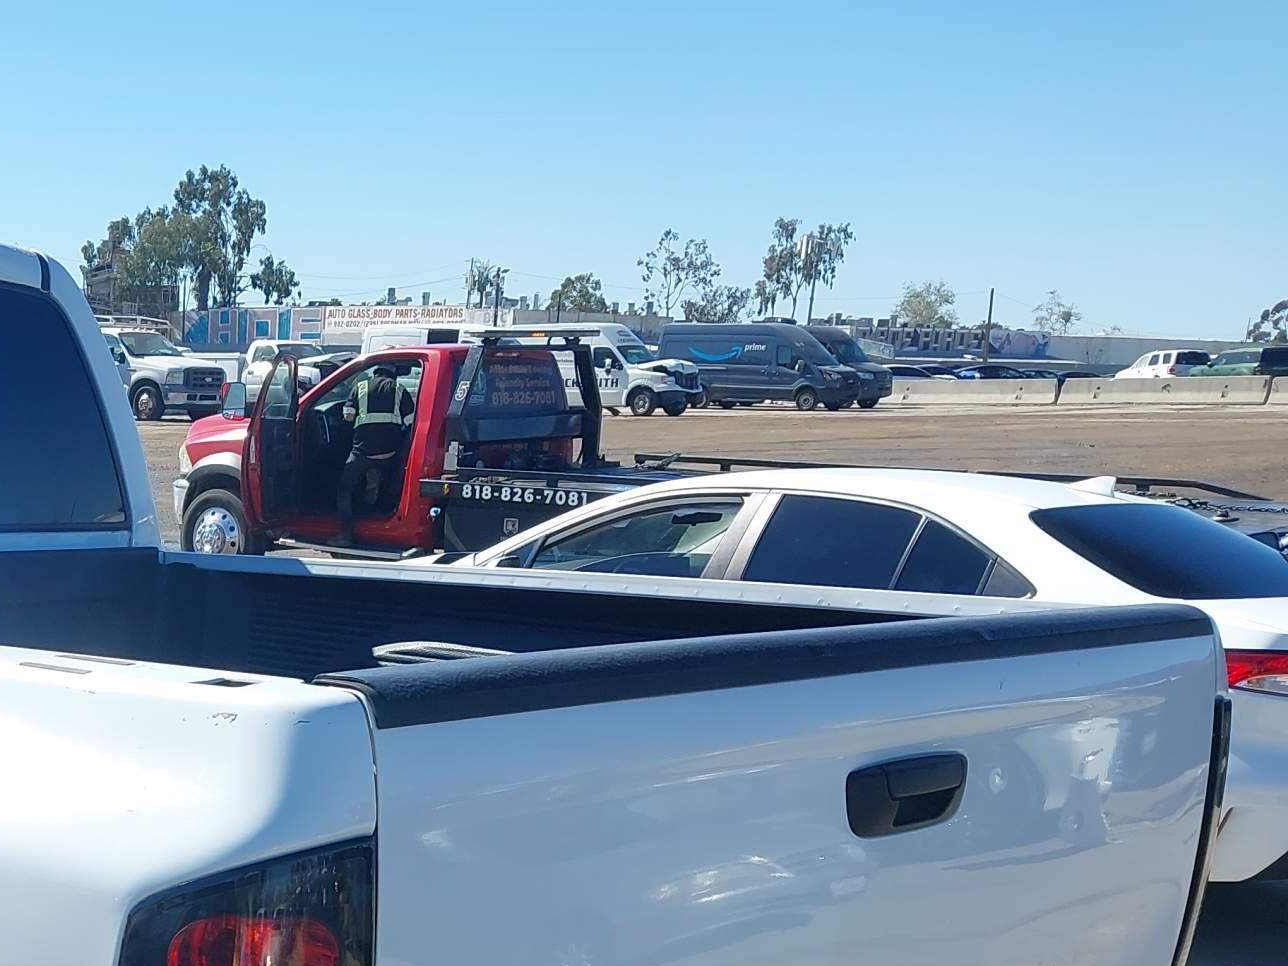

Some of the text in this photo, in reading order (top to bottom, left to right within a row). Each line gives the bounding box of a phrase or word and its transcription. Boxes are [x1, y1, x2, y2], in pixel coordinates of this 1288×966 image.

[327, 309, 346, 319] AUTO
[744, 342, 767, 352] prime
[454, 380, 471, 401] 5
[492, 391, 556, 406] 818-826-7081
[462, 484, 588, 506] 818-826-7081
